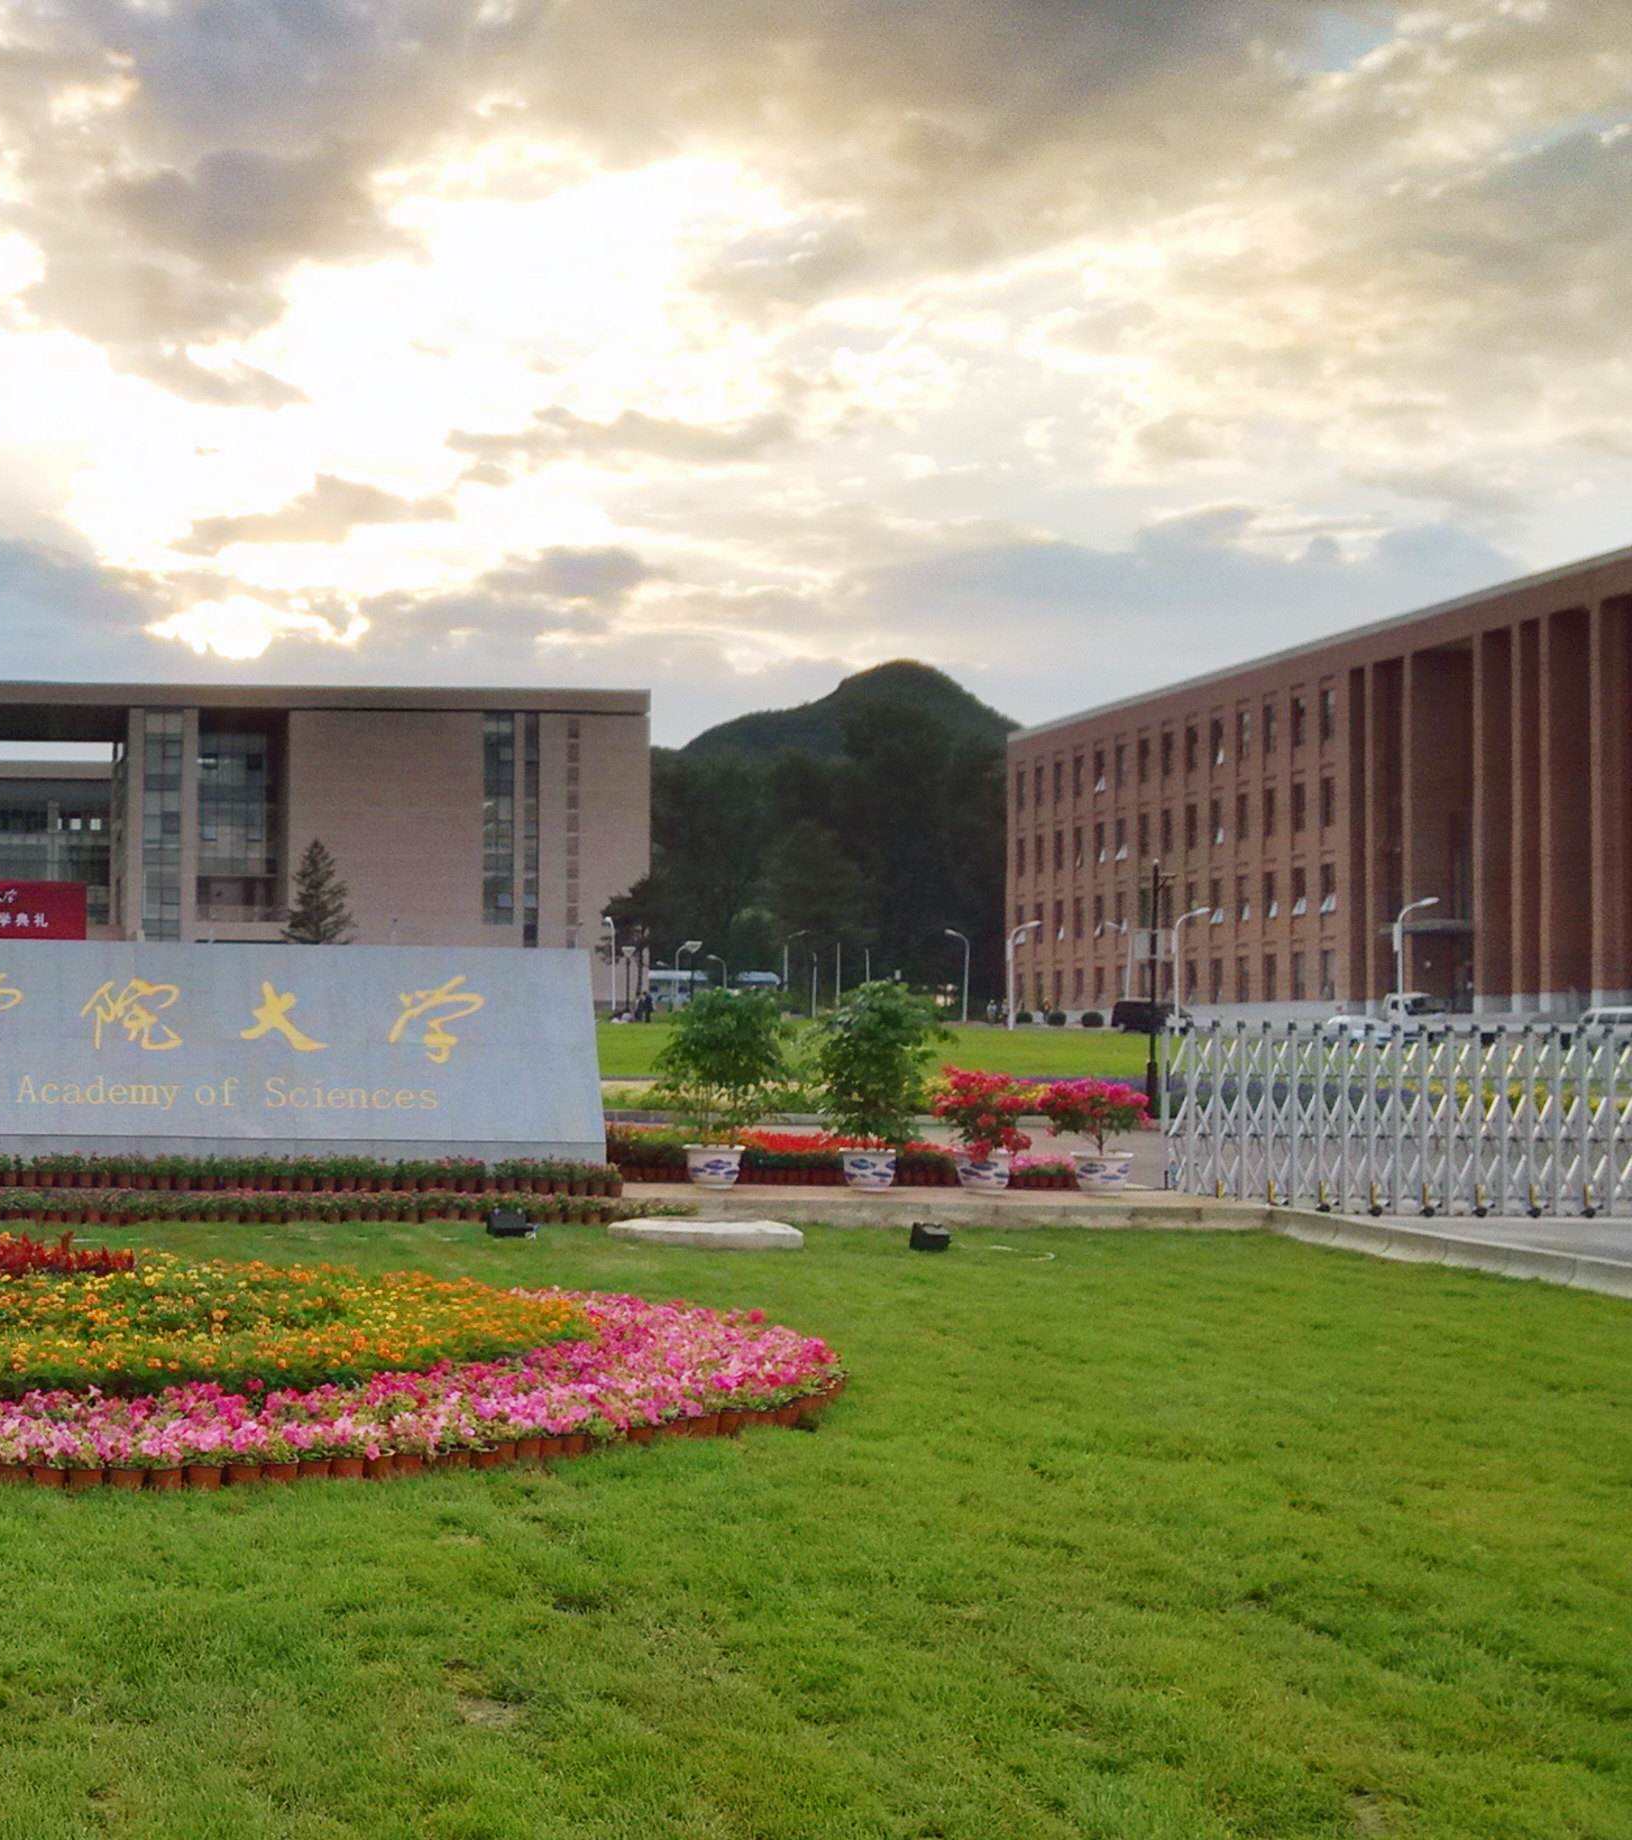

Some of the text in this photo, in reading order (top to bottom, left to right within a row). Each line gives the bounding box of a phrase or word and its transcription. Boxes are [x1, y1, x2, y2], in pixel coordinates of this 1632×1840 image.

[17, 1076, 182, 1111] Academy
[195, 1077, 240, 1109] of
[265, 1079, 439, 1111] Sciences
